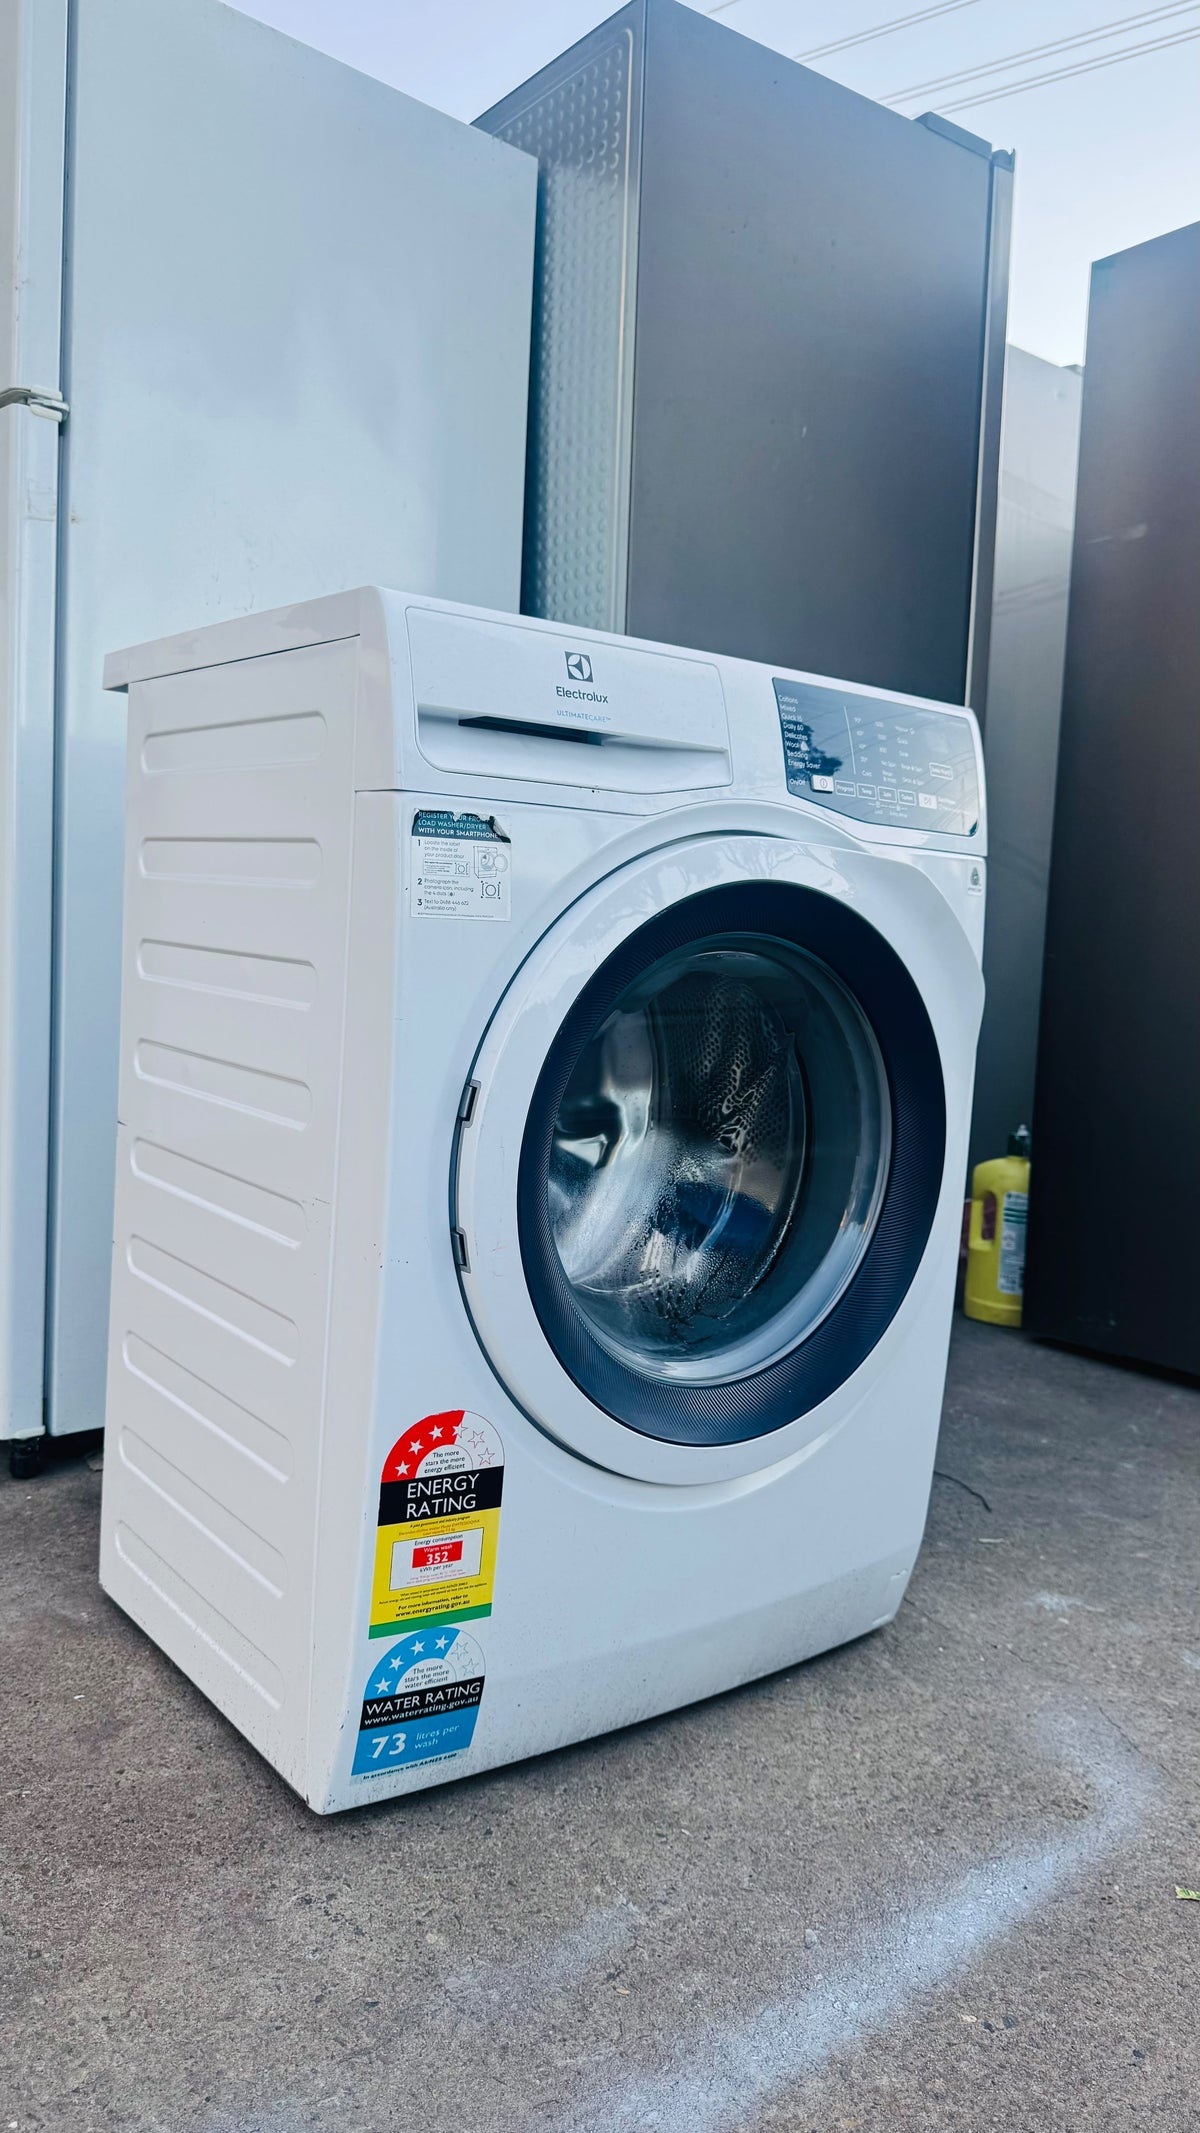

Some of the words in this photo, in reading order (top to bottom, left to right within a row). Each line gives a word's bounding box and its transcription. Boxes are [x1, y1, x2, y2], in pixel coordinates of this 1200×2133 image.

[556, 686, 608, 703] Electrolux
[778, 695, 798, 704] Cottons
[783, 722, 796, 730] Daily
[785, 731, 808, 740] Delicates
[787, 750, 808, 760] Bedding
[788, 759, 805, 768] Energy
[437, 821, 486, 830] WASHER/DRYER
[456, 830, 498, 838] SMARTPHONE
[407, 1473, 479, 1498] ENERGY
[406, 1494, 476, 1519] RATING
[432, 1534, 463, 1544] consumption
[426, 1552, 448, 1564] 352
[422, 1597, 450, 1606] information,
[396, 1600, 470, 1617] www.energyrating.gov.au
[424, 1676, 448, 1685] efficient
[366, 1696, 420, 1715] WATER
[426, 1682, 480, 1704] RATING
[364, 1696, 479, 1726] www.waterrating.gov.au
[372, 1732, 406, 1758] 73
[416, 1730, 440, 1740] litres
[442, 1725, 459, 1736] per
[414, 1738, 438, 1749] wash
[371, 1767, 404, 1778] accordance
